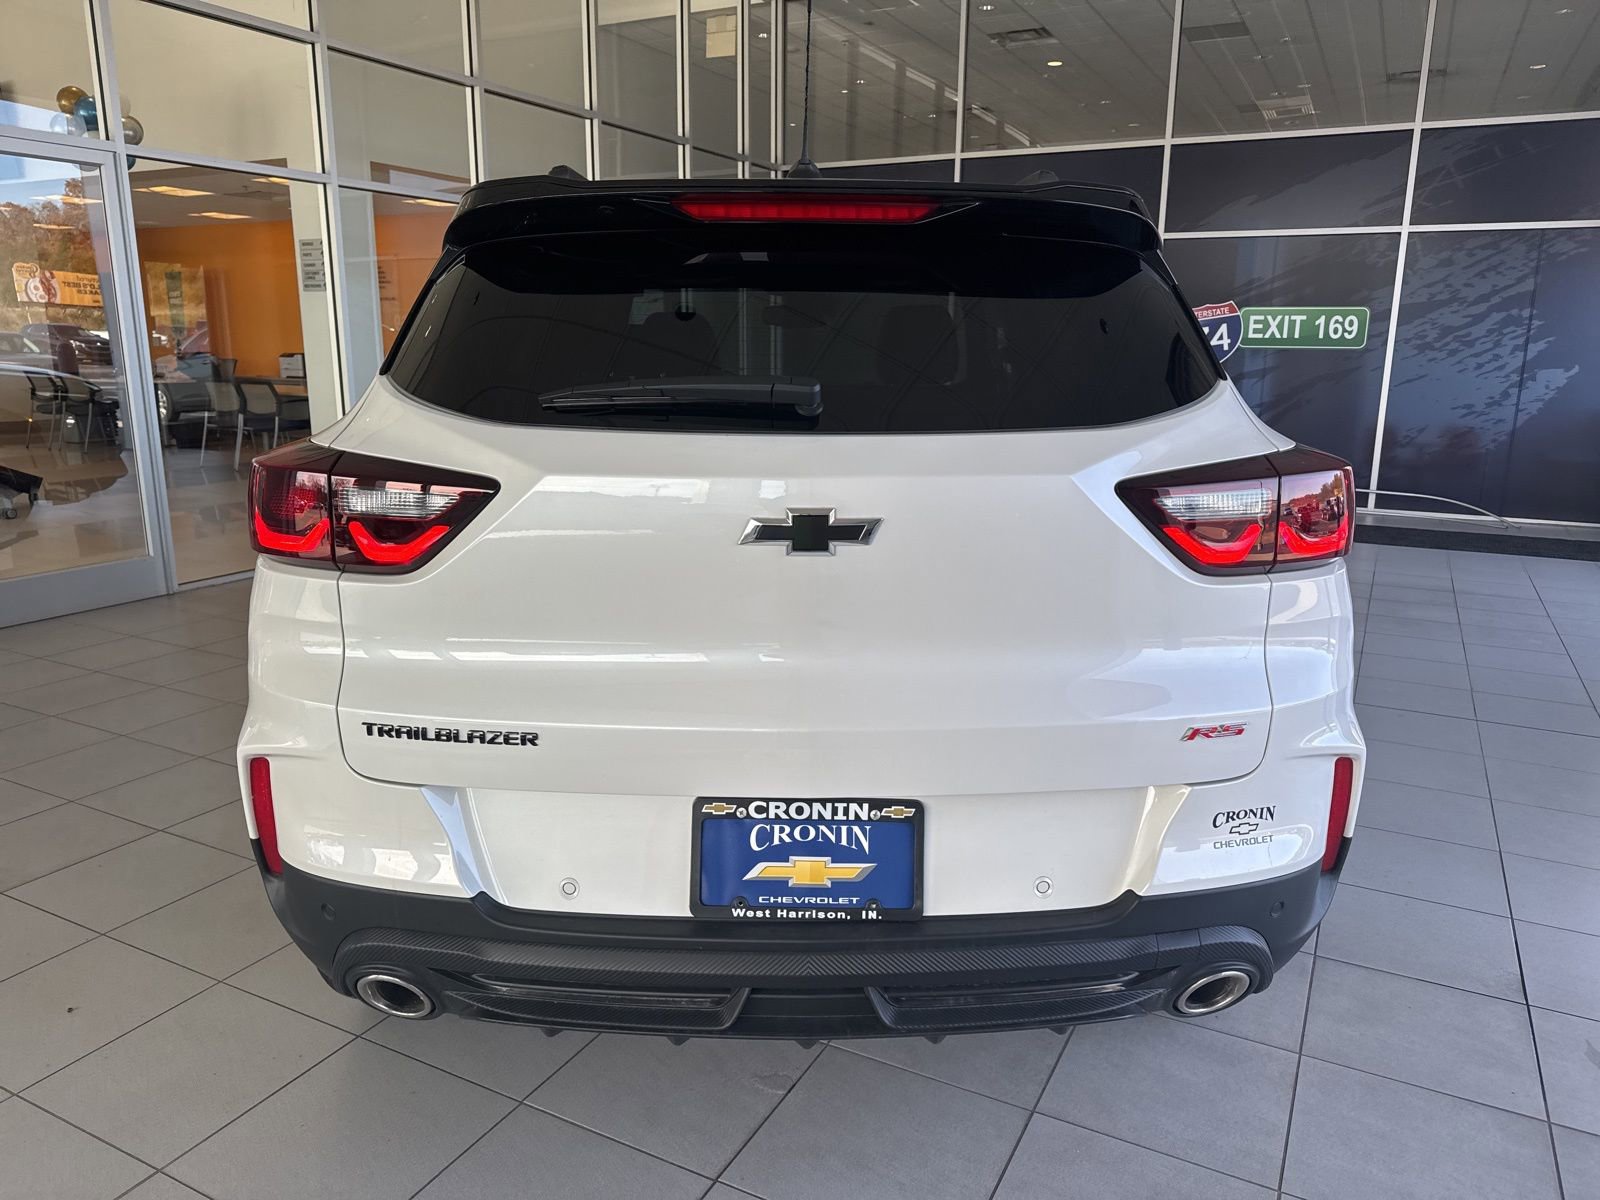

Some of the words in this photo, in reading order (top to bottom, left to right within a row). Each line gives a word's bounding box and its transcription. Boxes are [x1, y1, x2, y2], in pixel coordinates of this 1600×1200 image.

[1196, 307, 1230, 318] TERSTATE
[1247, 315, 1307, 339] EXIT
[1314, 315, 1359, 339] 169
[361, 722, 539, 747] TRAILBLAZER
[748, 801, 869, 821] CRONIN
[1212, 805, 1276, 829] CRONIN
[750, 823, 872, 855] CRONIN
[1213, 835, 1274, 850] CHEVROLET
[758, 896, 861, 904] CHEVROLET
[732, 908, 771, 918] West
[777, 908, 851, 920] Harrison,
[861, 910, 882, 920] IN.
